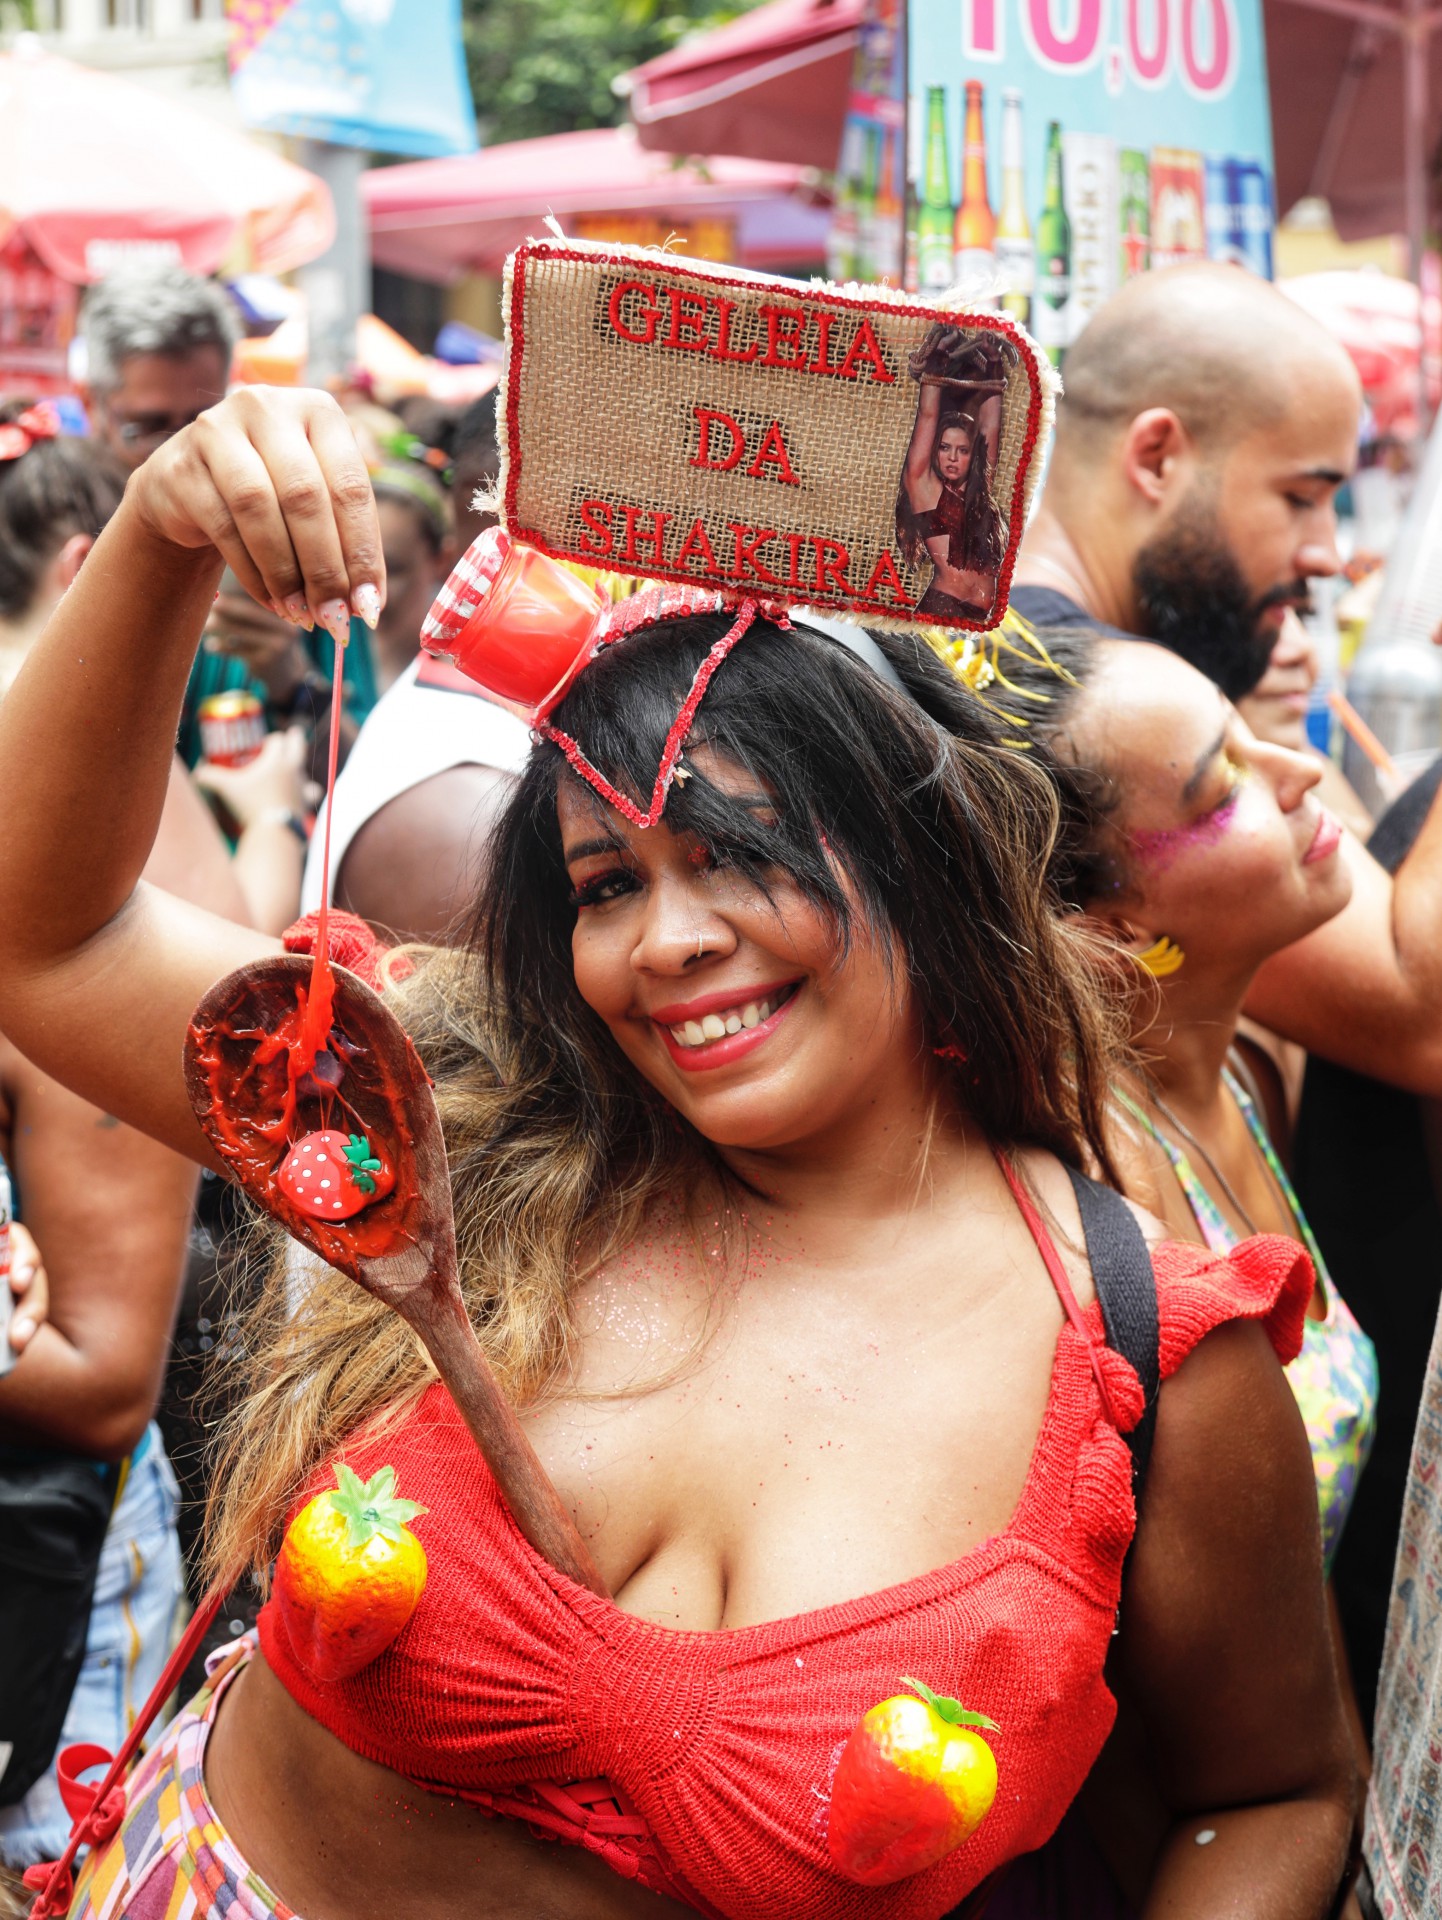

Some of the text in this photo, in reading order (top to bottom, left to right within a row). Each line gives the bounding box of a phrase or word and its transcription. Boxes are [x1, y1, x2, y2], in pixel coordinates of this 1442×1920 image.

[609, 280, 895, 383] GELEIA
[690, 407, 800, 486] DA
[580, 500, 917, 606] SHAKIRA
